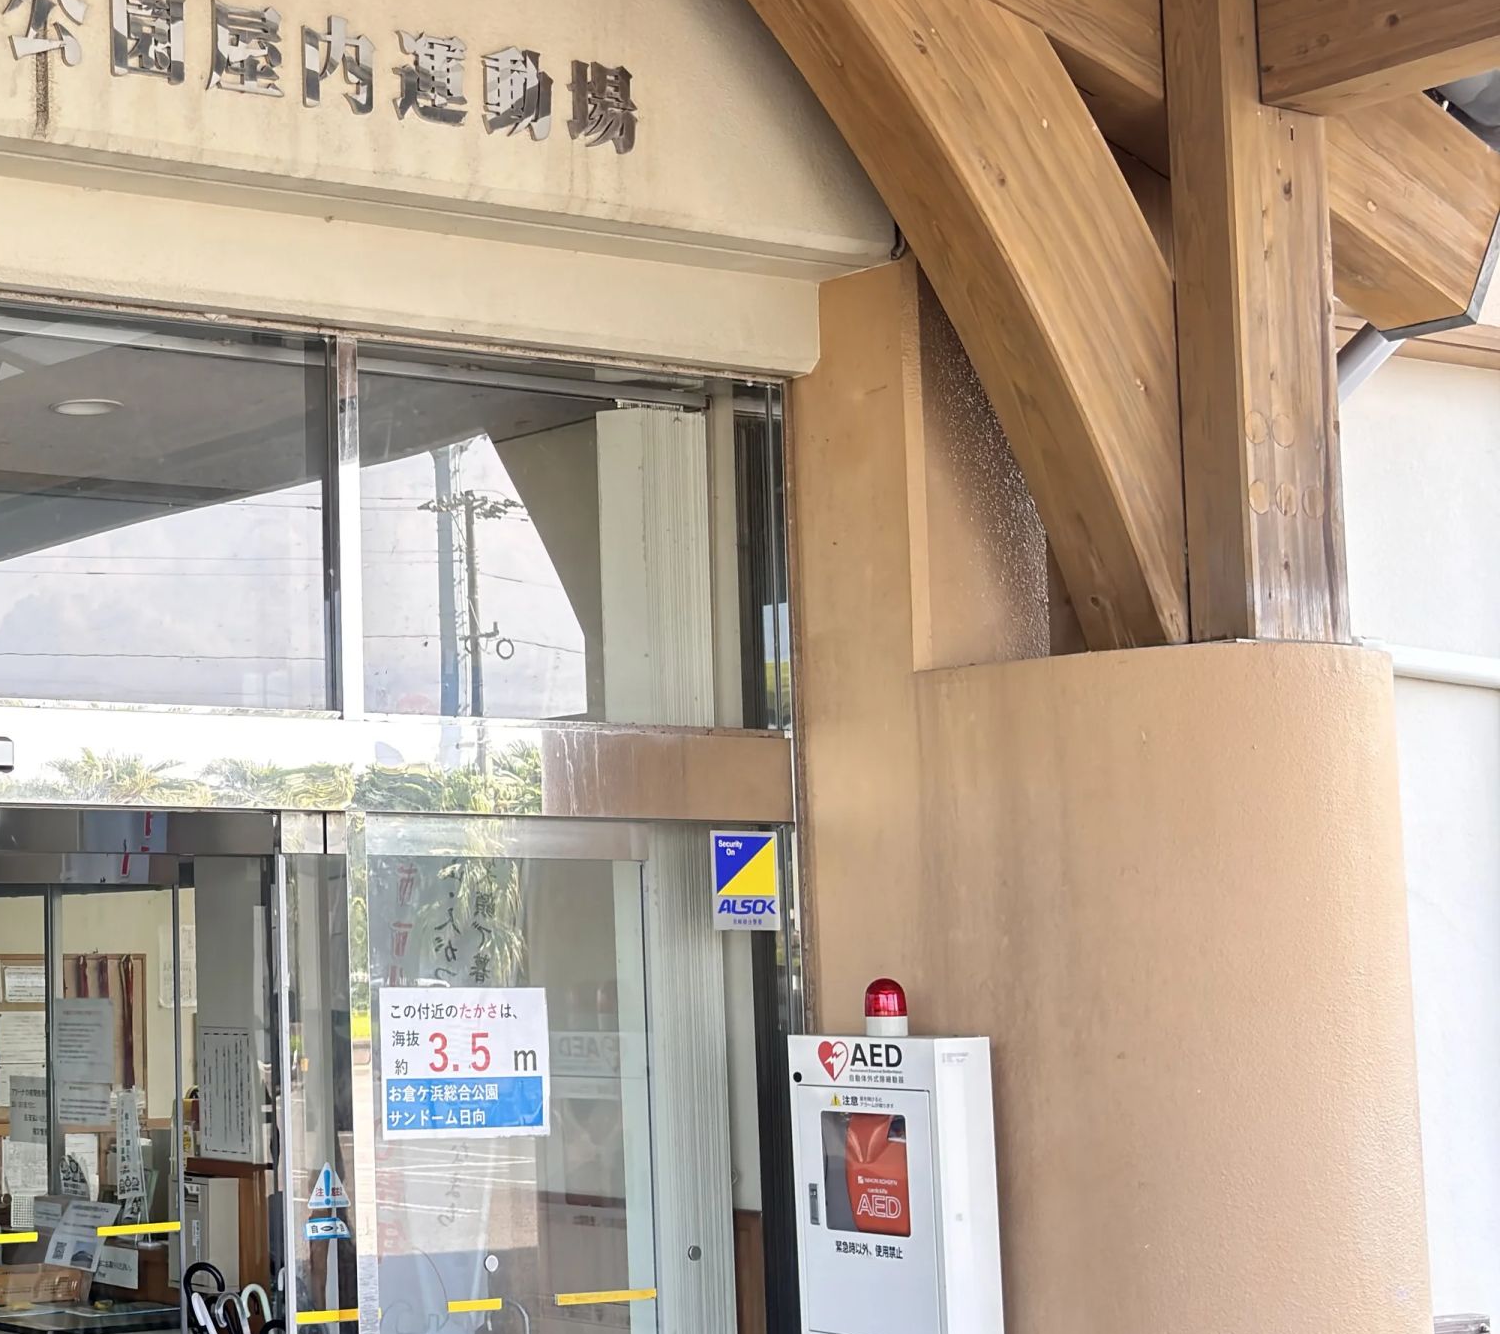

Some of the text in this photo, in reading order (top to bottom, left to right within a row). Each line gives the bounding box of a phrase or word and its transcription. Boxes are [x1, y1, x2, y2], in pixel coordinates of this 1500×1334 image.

[718, 839, 743, 849] Security
[725, 848, 736, 856] On
[717, 899, 777, 915] ALSOK
[390, 1002, 519, 1020] この付近のたかさは、
[392, 1030, 420, 1047] 海抜
[394, 1032, 537, 1076] 約 3.5 m
[850, 1043, 903, 1068] AED
[842, 1095, 859, 1106] 注意
[388, 1109, 486, 1126] サンドーム日向
[856, 1193, 902, 1219] AED
